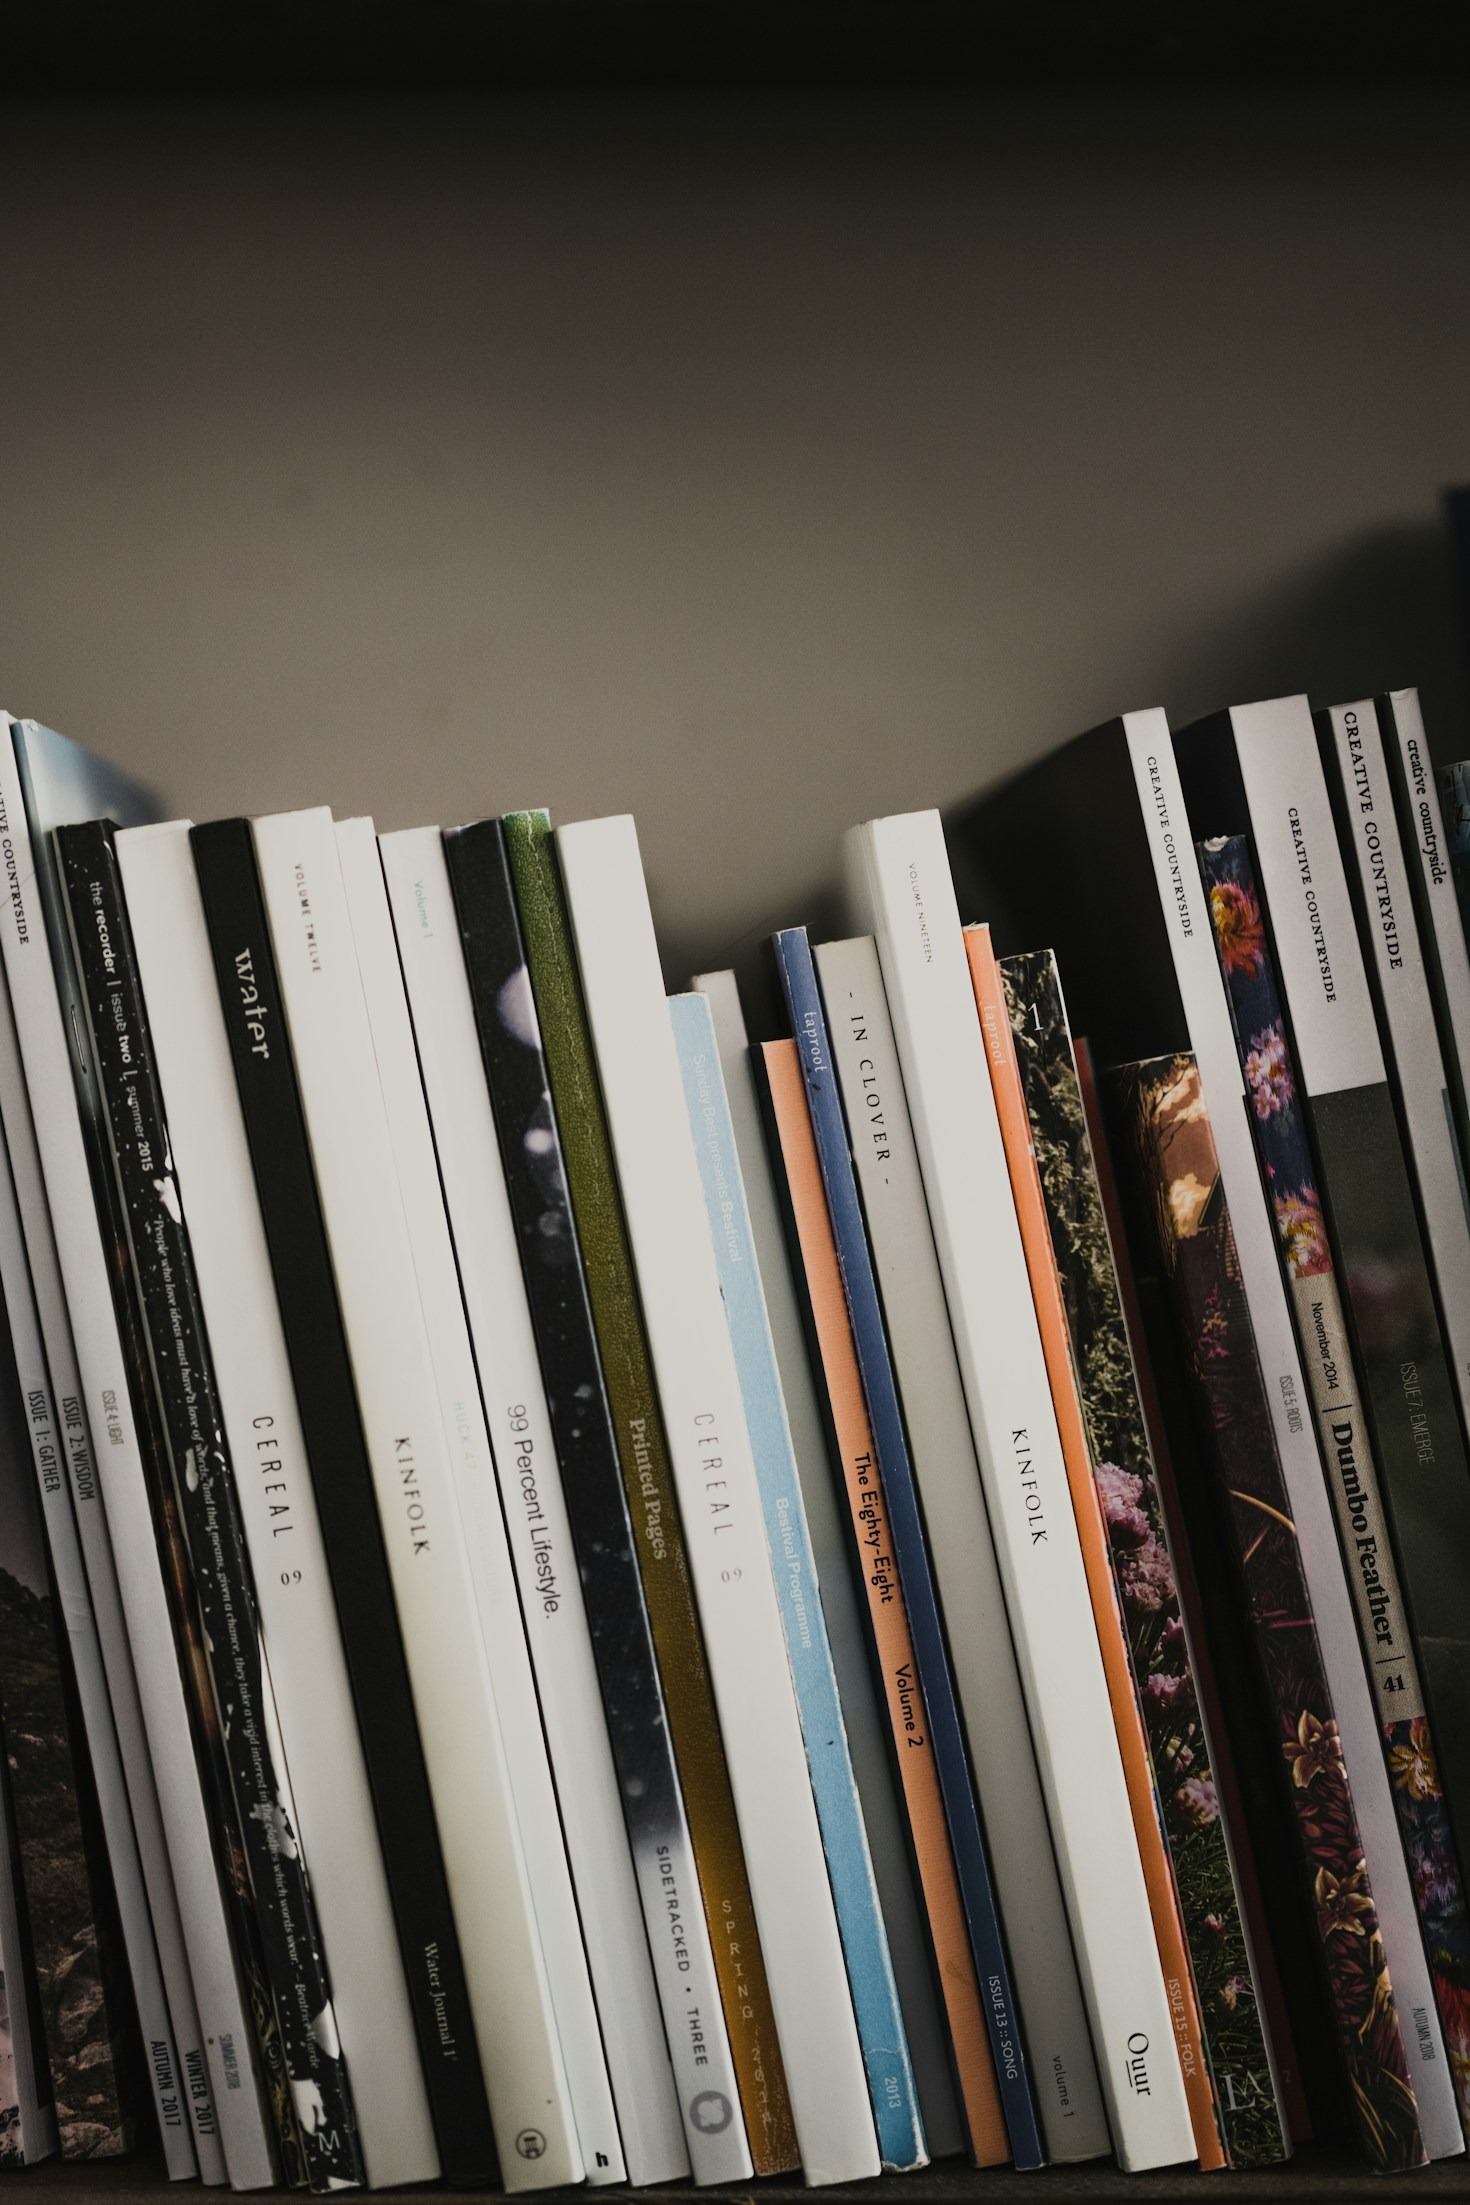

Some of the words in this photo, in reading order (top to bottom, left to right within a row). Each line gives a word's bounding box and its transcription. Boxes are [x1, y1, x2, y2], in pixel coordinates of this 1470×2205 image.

[1407, 739, 1428, 796] creative
[1418, 801, 1447, 885] countryside
[1147, 756, 1170, 829] CREATIVE
[1163, 833, 1194, 938] COUNTRYSIDE
[1343, 711, 1374, 814] CREATIVE
[1364, 821, 1403, 970] COUNTRYSIDE
[2, 838, 29, 945] COUNTRYSIDE
[89, 881, 103, 908] the
[413, 879, 429, 929] Volume
[909, 863, 923, 907] VOLUME
[917, 912, 932, 963] NINETEEN
[1288, 807, 1312, 885] CREATIVE
[1305, 890, 1337, 1003] COUNTRYSIDE
[95, 909, 116, 974] recorder
[294, 863, 311, 916] VOLUME
[305, 923, 321, 972] TWELVE
[111, 993, 127, 1032] issue
[234, 947, 270, 1059] water
[1027, 1002, 1045, 1031] 1
[118, 1034, 132, 1064] two
[804, 1010, 828, 1074] taproot
[982, 1003, 1007, 1067] taproot
[689, 1054, 711, 1104] Sunday
[850, 1015, 868, 1041] IN
[859, 1059, 891, 1161] CLOVER
[125, 1085, 145, 1139] summer
[703, 1106, 720, 1139] Best
[137, 1140, 154, 1172] 2015
[705, 1140, 729, 1199] presents
[720, 1200, 743, 1263] Bestival
[160, 1258, 173, 1283] who
[164, 1283, 178, 1307] love
[169, 1306, 184, 1338] ideas
[1311, 1302, 1331, 1360] November
[1322, 1361, 1340, 1390] 2014
[175, 1338, 190, 1367] must
[181, 1368, 194, 1397] have
[1279, 1374, 1297, 1399] ISSUE
[1399, 1361, 1422, 1399] ISSUE
[62, 1396, 83, 1430] ISSUE
[187, 1405, 200, 1429] love
[191, 1429, 204, 1443] of
[452, 1401, 473, 1445] HUCK
[463, 1451, 477, 1469] 47
[507, 1404, 529, 1432] 99
[1286, 1407, 1304, 1434] ROOTS
[27, 1389, 48, 1424] ISSUE
[38, 1444, 62, 1495] GATHER
[629, 1417, 660, 1498] Printed
[1410, 1413, 1436, 1465] EMERGE
[72, 1449, 97, 1502] WISDOM
[513, 1439, 545, 1522] Percent
[854, 1451, 872, 1486] The
[1012, 1428, 1048, 1545] KINFOLK
[204, 1506, 219, 1532] that
[252, 1415, 294, 1538] CEREAL
[280, 1570, 302, 1586] 09
[394, 1436, 430, 1556] KINFOLK
[693, 1413, 734, 1535] CEREAL
[720, 1568, 743, 1583] 09
[644, 1498, 668, 1561] Pages
[858, 1490, 894, 1604] Eighty-Eight
[1331, 1421, 1369, 1533] Dumbo
[1355, 1535, 1394, 1648] Feather
[216, 1572, 231, 1602] given
[530, 1526, 561, 1619] Lifestyle.
[775, 1497, 799, 1560] Bestival
[787, 1561, 812, 1649] Programme
[231, 1656, 246, 1682] they
[1382, 1674, 1406, 1693] 41
[238, 1682, 252, 1708] take
[895, 1663, 917, 1732] Volume
[908, 1735, 925, 1749] 2
[250, 1746, 268, 1789] interest
[273, 1863, 288, 1897] which
[279, 1898, 295, 1934] words
[424, 1941, 441, 1988] Water
[656, 1845, 690, 1972] SIDETRACKED
[686, 2007, 709, 2066] THREE
[721, 1899, 753, 2019] SPRING
[988, 1975, 1005, 2011] ISSUE
[1168, 1978, 1185, 2014] ISSUE
[429, 1991, 456, 2046] Journal
[995, 2012, 1008, 2028] 13
[1175, 2015, 1189, 2031] 15
[1412, 2008, 1431, 2042] AUTUMN
[150, 2041, 175, 2091] AUTUMN
[184, 2049, 207, 2100] WINTER
[1000, 2040, 1018, 2080] SONG
[1127, 2032, 1151, 2096] Ouur
[1180, 2043, 1197, 2078] FOLK
[1419, 2041, 1436, 2061] 2018
[884, 2076, 902, 2109] 2013
[1052, 2055, 1070, 2106] volume
[161, 2095, 182, 2126] 2017
[194, 2104, 216, 2136] 2017
